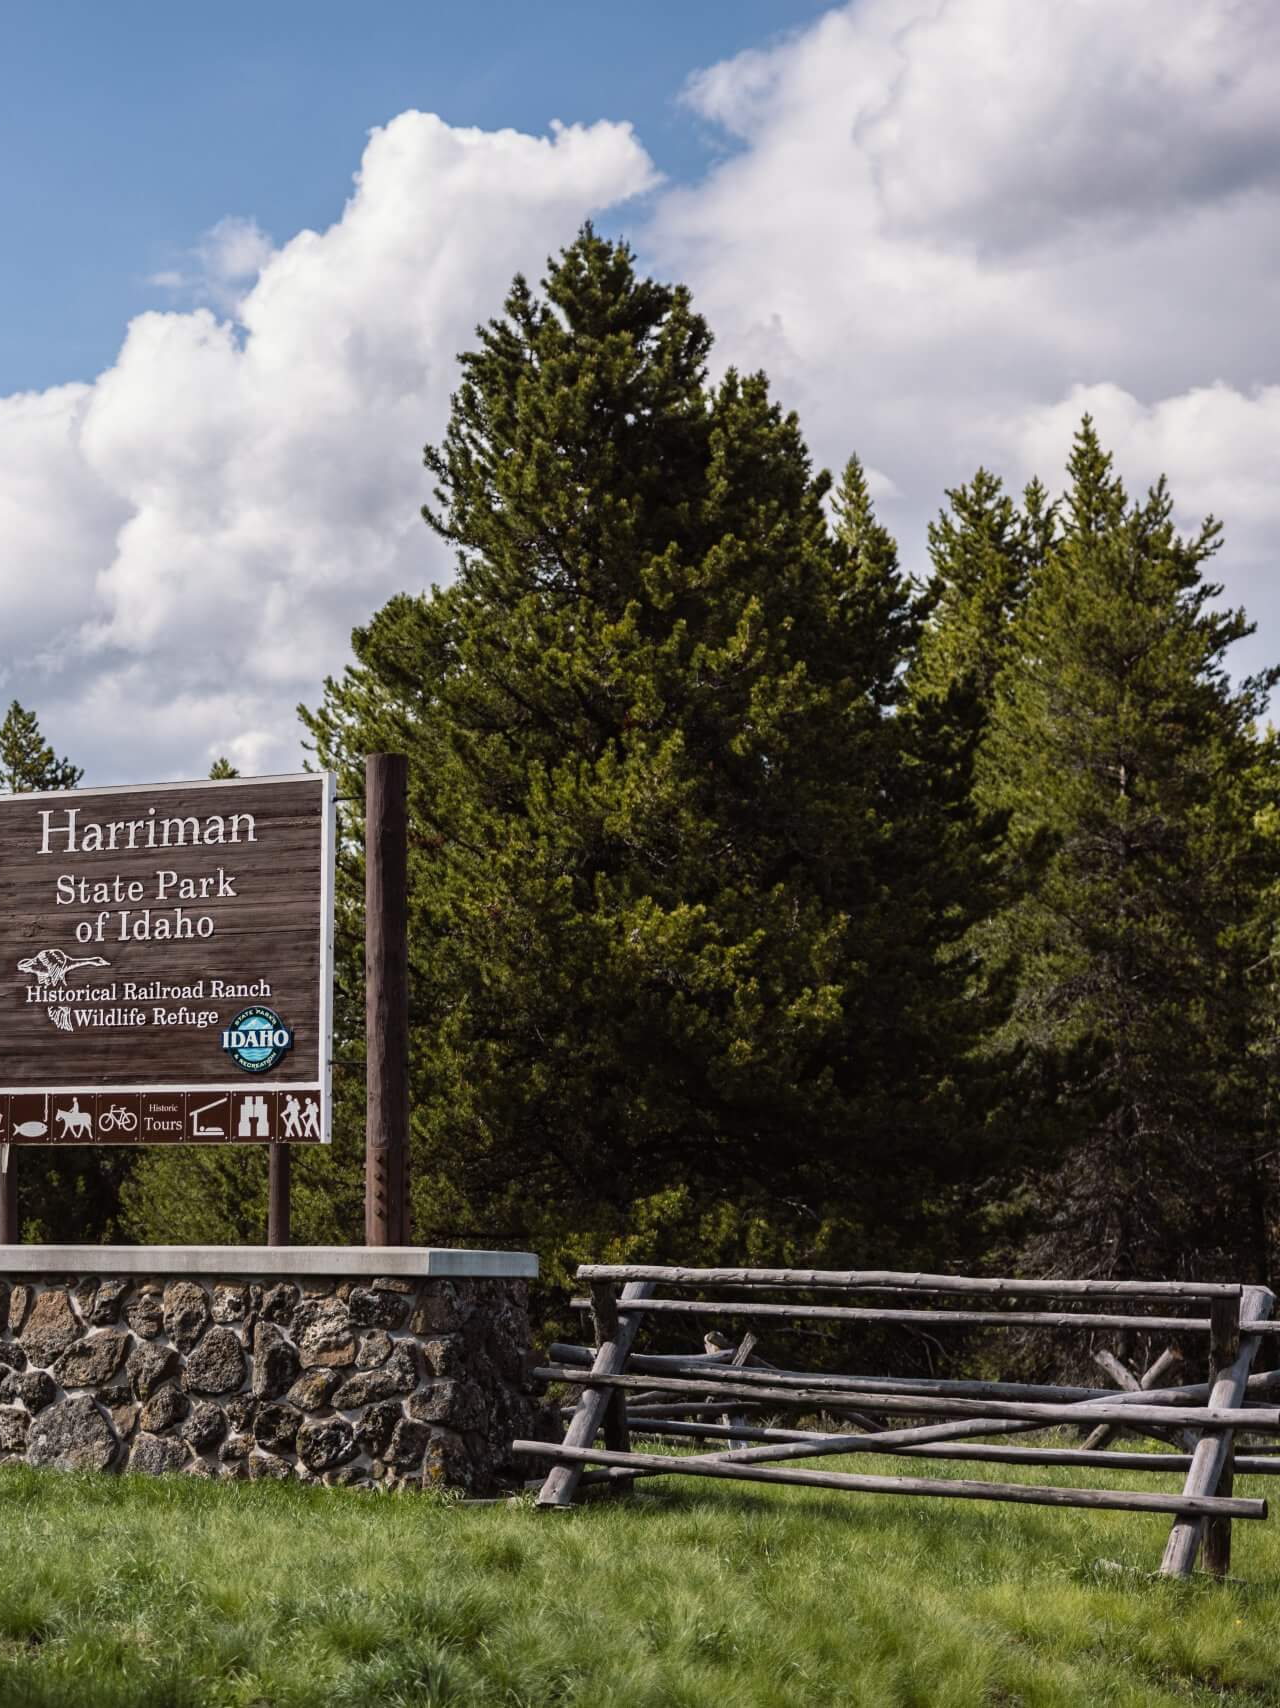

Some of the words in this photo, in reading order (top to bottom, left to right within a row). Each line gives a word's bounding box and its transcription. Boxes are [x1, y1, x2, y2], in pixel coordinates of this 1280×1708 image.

[36, 808, 258, 855] Harriman
[56, 873, 145, 905] State
[155, 867, 237, 900] Park
[75, 911, 109, 943] of
[118, 908, 215, 942] Idaho
[25, 982, 117, 1003] Historical
[123, 981, 204, 1001] Railroad
[210, 979, 272, 999] Ranch
[73, 1007, 146, 1028] Wildlife
[153, 1007, 219, 1029] Refuge
[234, 1009, 254, 1026] STATE
[256, 1009, 277, 1025] PARKS
[222, 1029, 289, 1049] IDAHO
[239, 1052, 277, 1069] RECREATION
[149, 1103, 179, 1112] Historic
[143, 1117, 183, 1131] Tours
